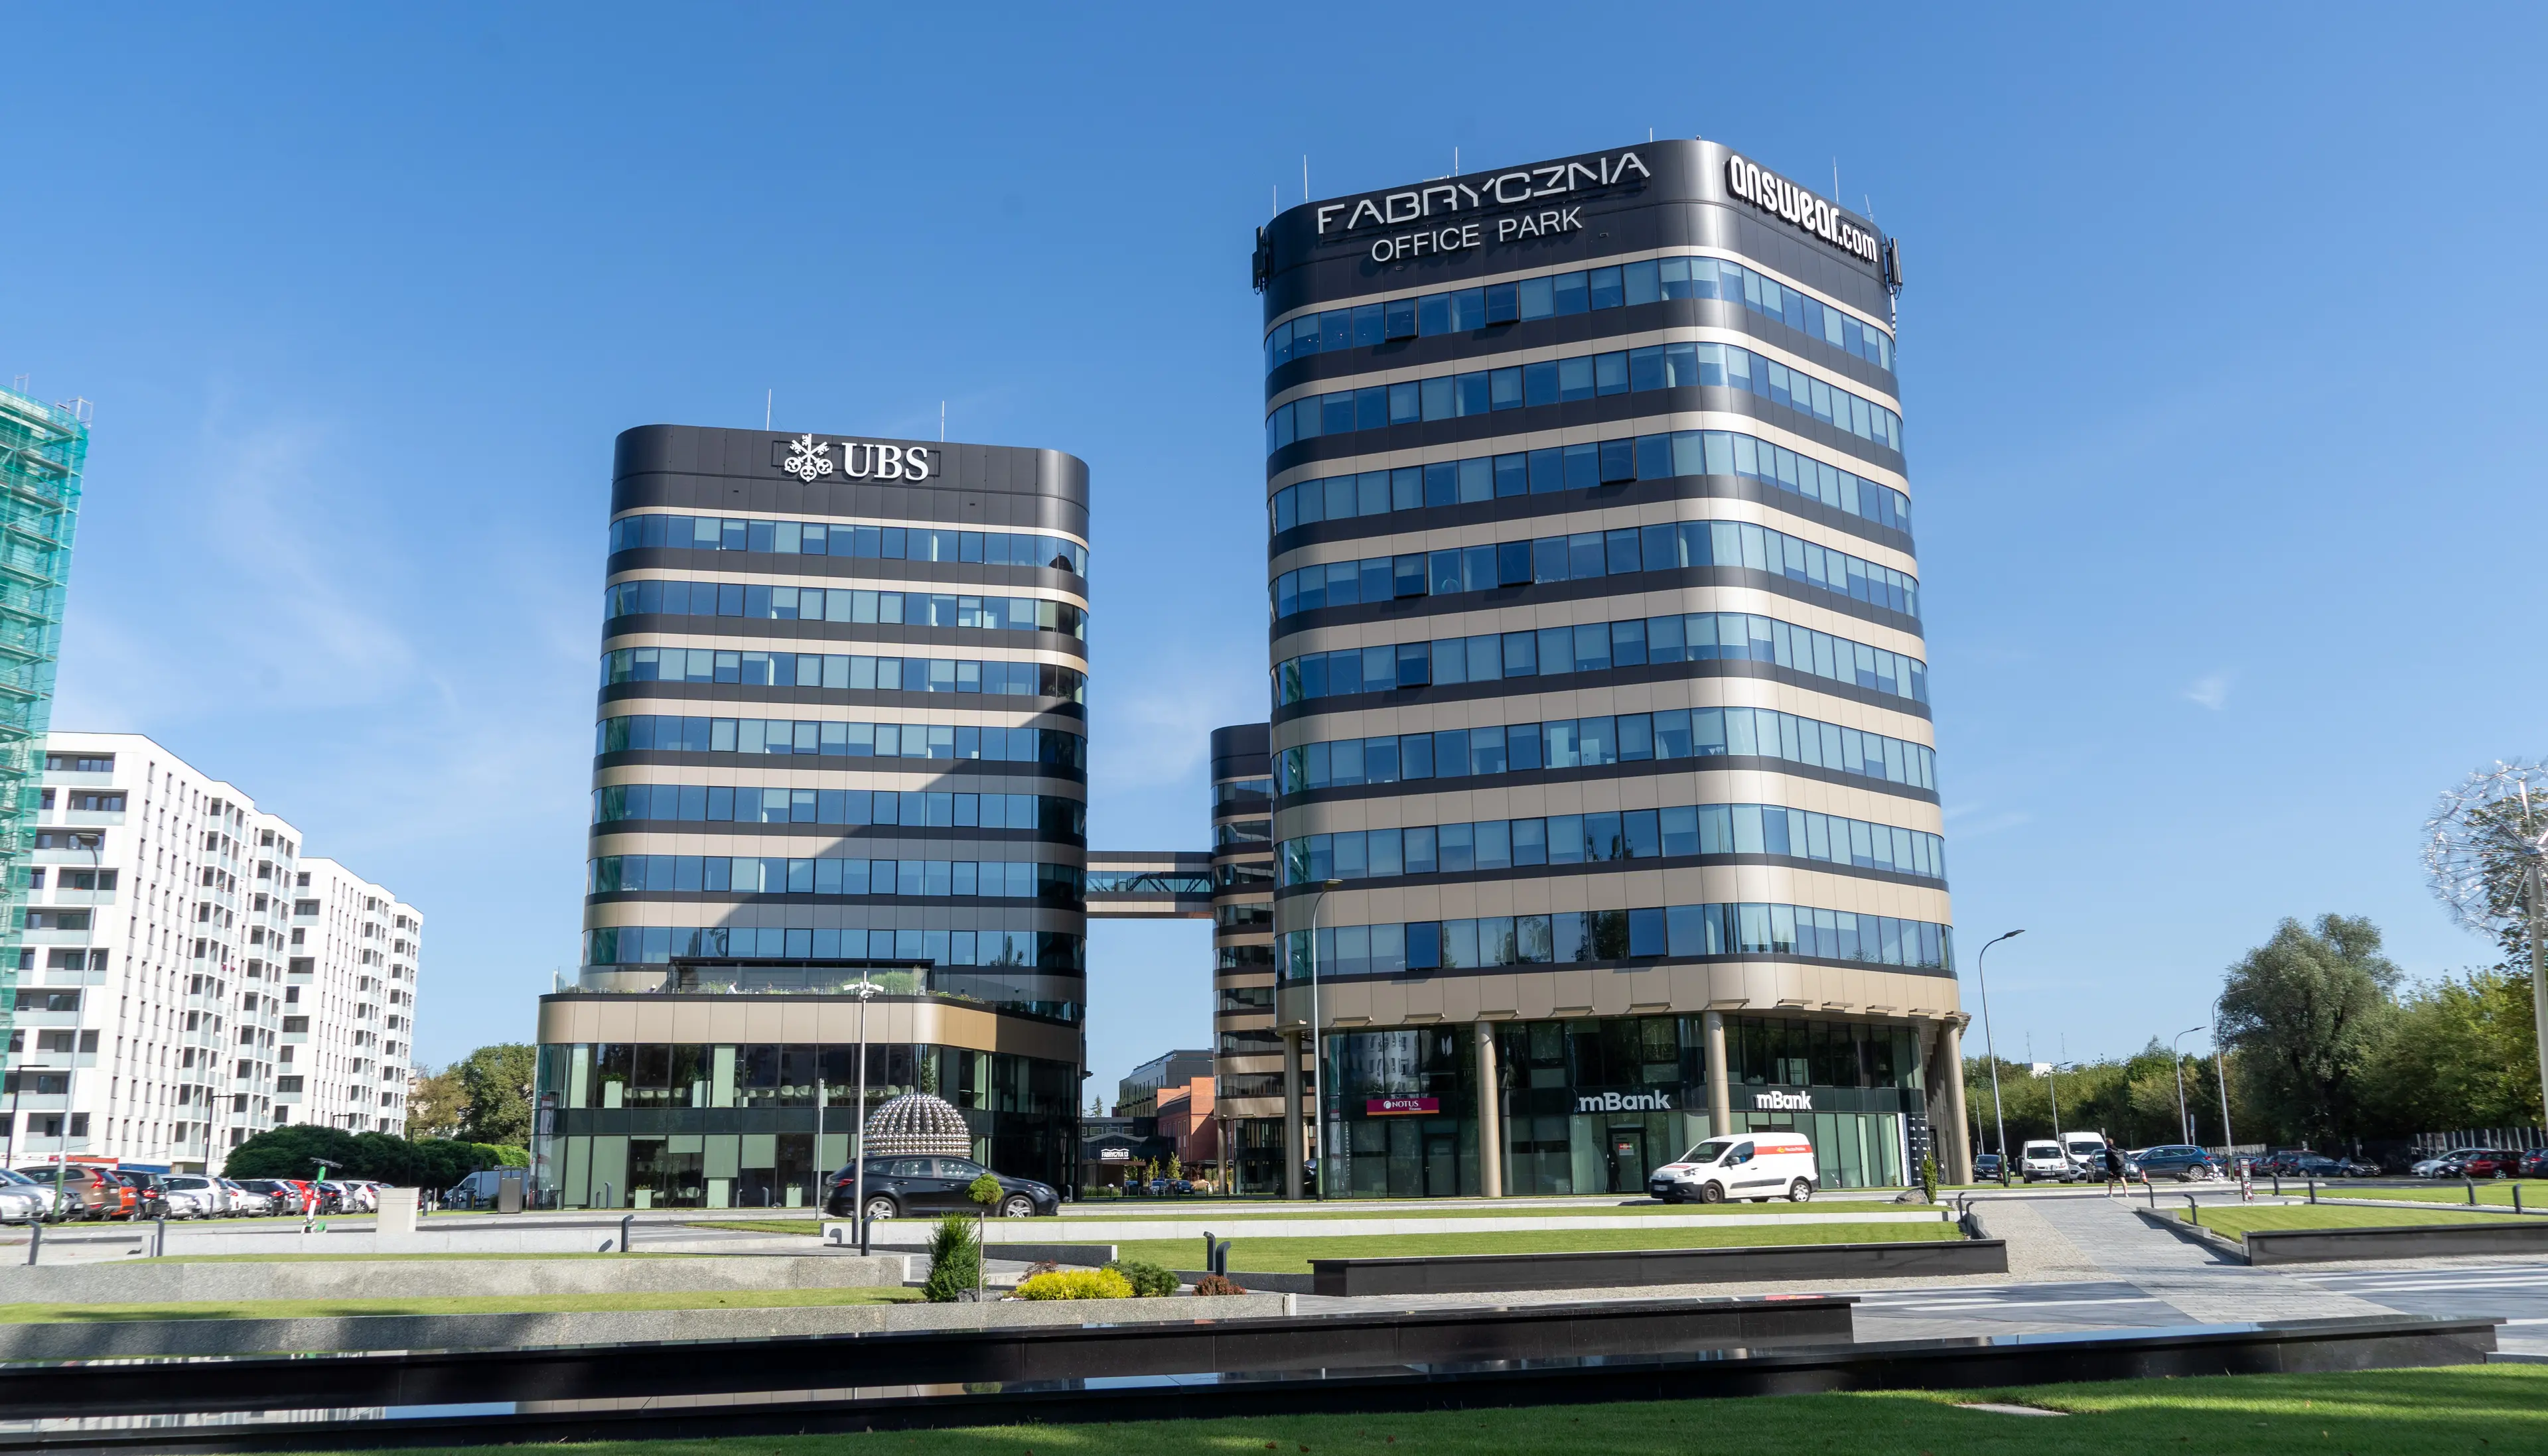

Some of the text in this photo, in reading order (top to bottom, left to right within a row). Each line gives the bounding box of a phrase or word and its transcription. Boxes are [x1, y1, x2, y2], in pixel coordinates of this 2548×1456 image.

[1318, 152, 1651, 233] FABRYCZNA
[1731, 155, 1878, 263] answear.com
[1372, 206, 1583, 262] OFFICE PARK
[841, 442, 929, 480] UBS
[1579, 1090, 1671, 1112] mBank
[1756, 1091, 1812, 1109] mBank
